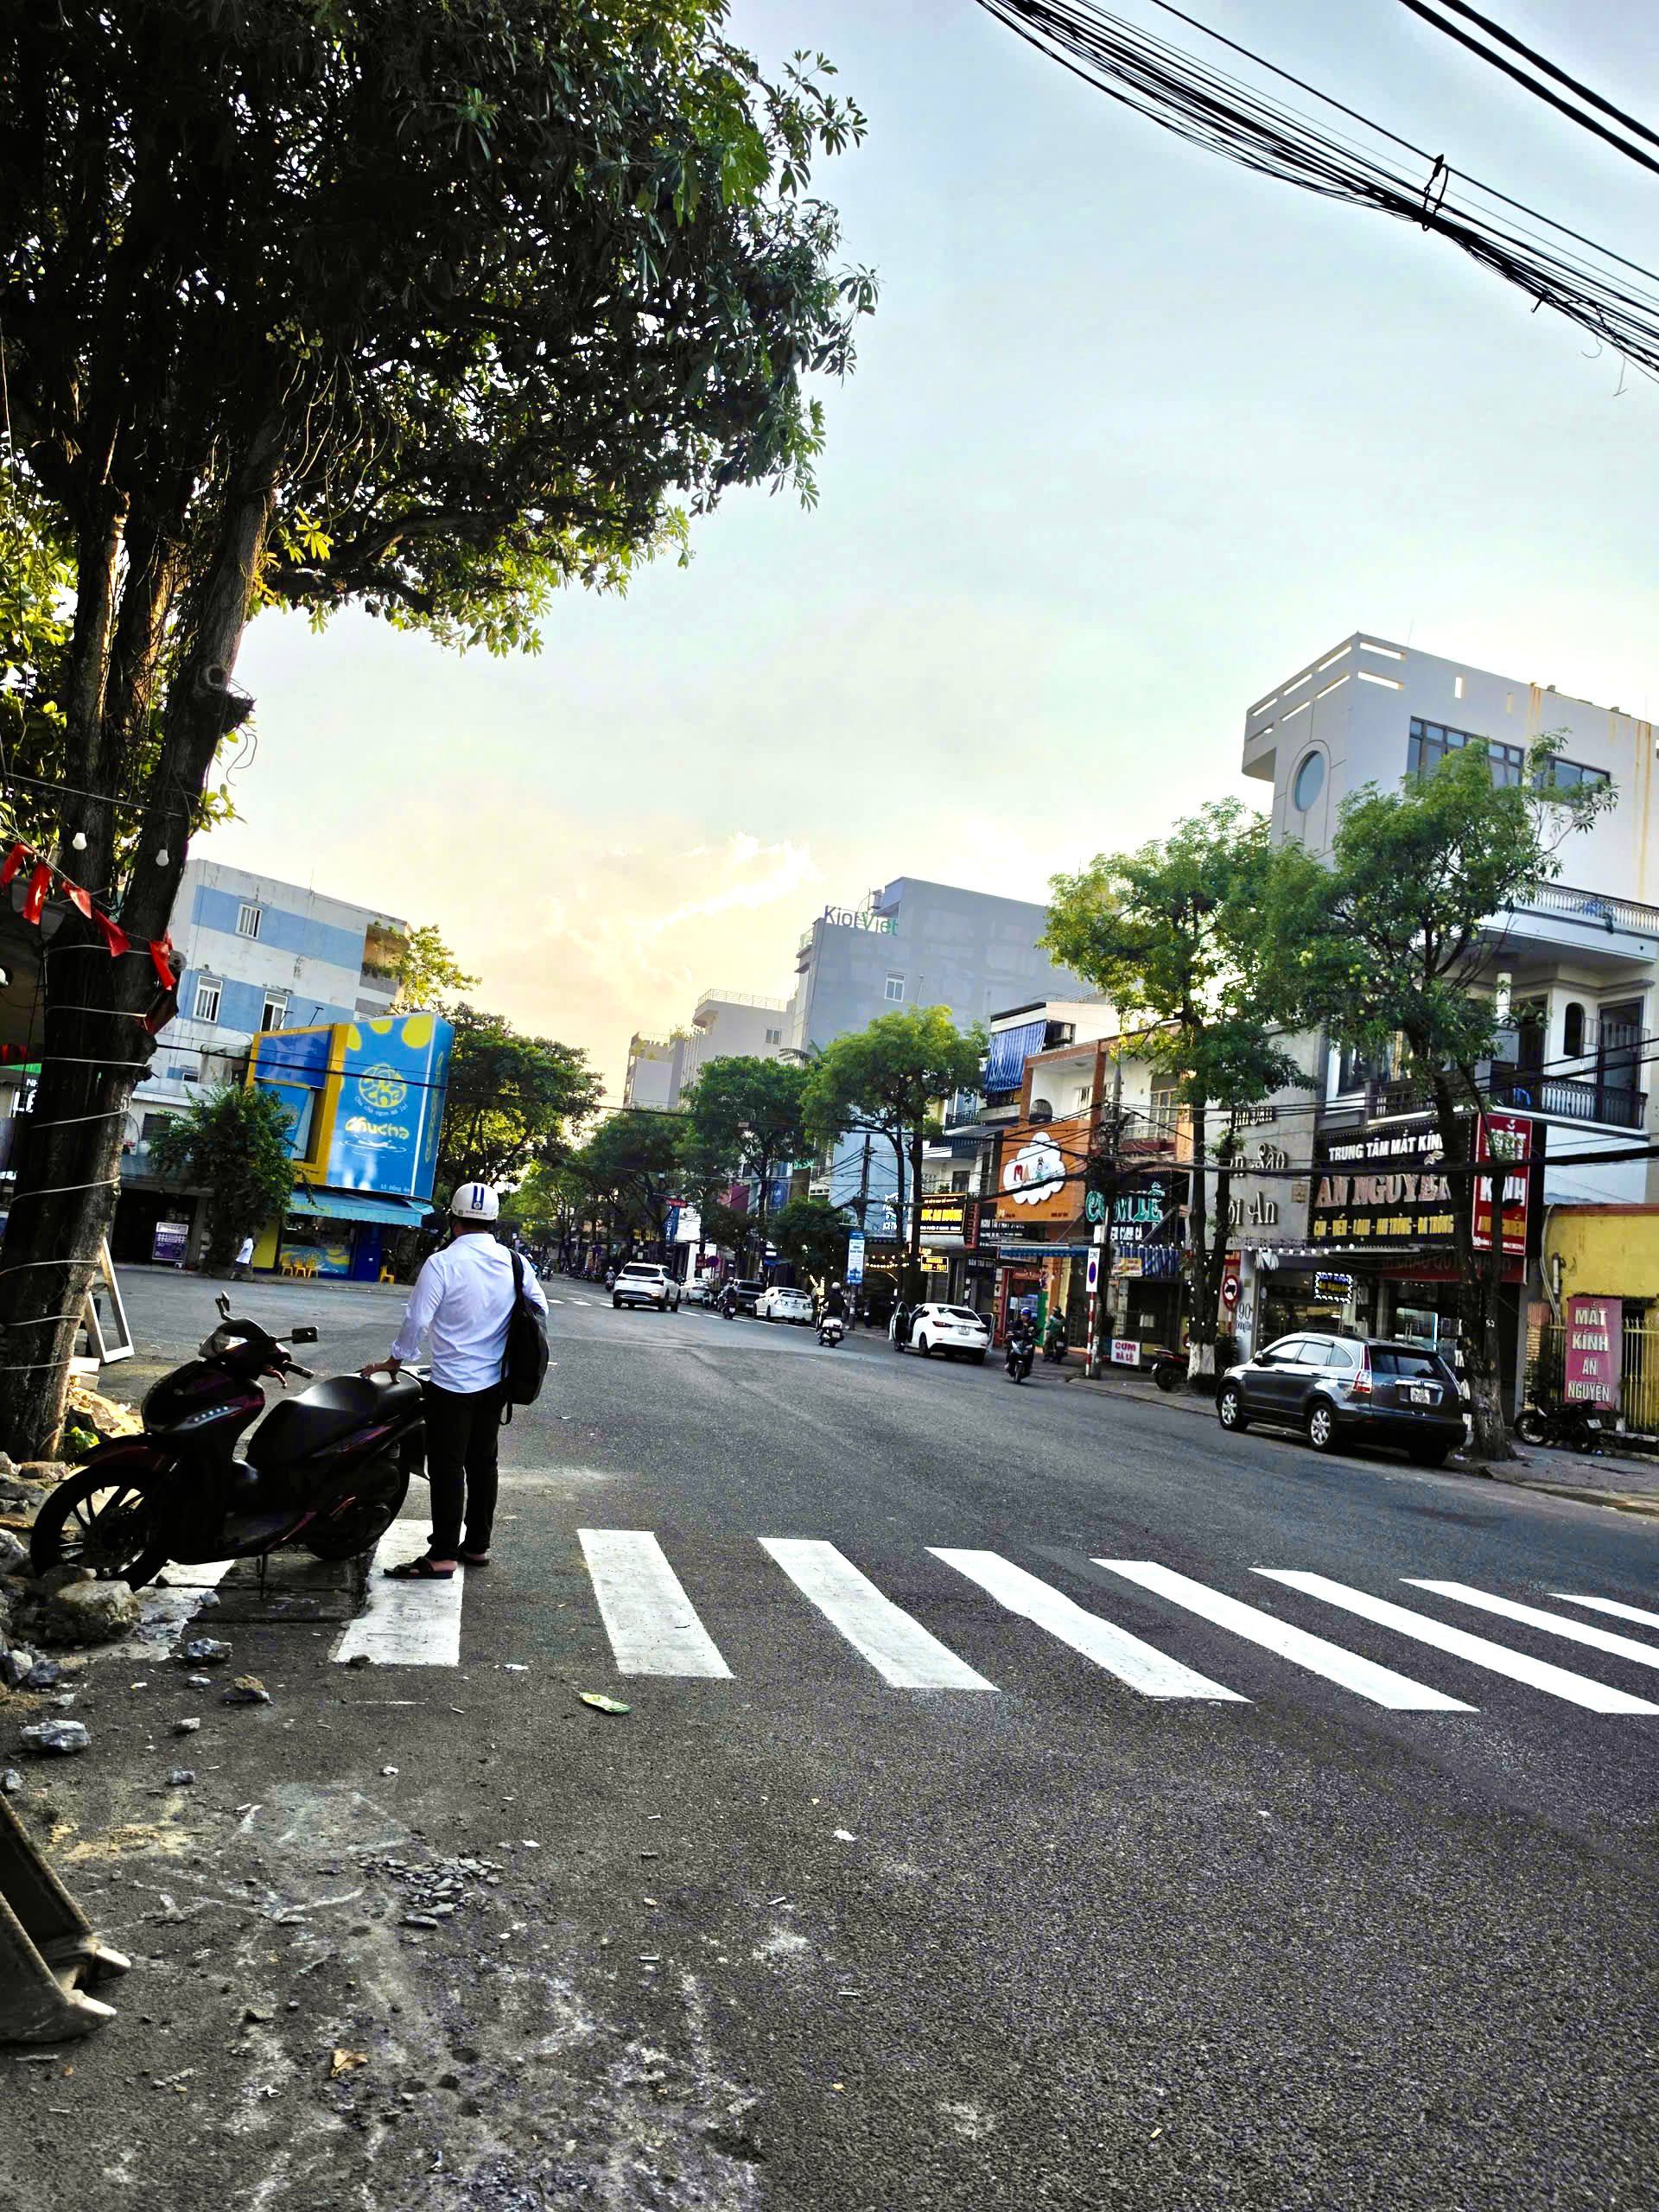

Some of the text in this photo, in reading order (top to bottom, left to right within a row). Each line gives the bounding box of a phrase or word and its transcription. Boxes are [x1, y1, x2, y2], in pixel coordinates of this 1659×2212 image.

[824, 905, 899, 937] KiotViet
[1329, 1129, 1444, 1161] TRUNG TÂM MẮT KÍN
[1314, 1175, 1350, 1207] AN
[1479, 1175, 1527, 1206] KNH
[1575, 1300, 1607, 1326] MẮT
[1572, 1329, 1610, 1352] KÍNH
[1582, 1358, 1598, 1376] AN
